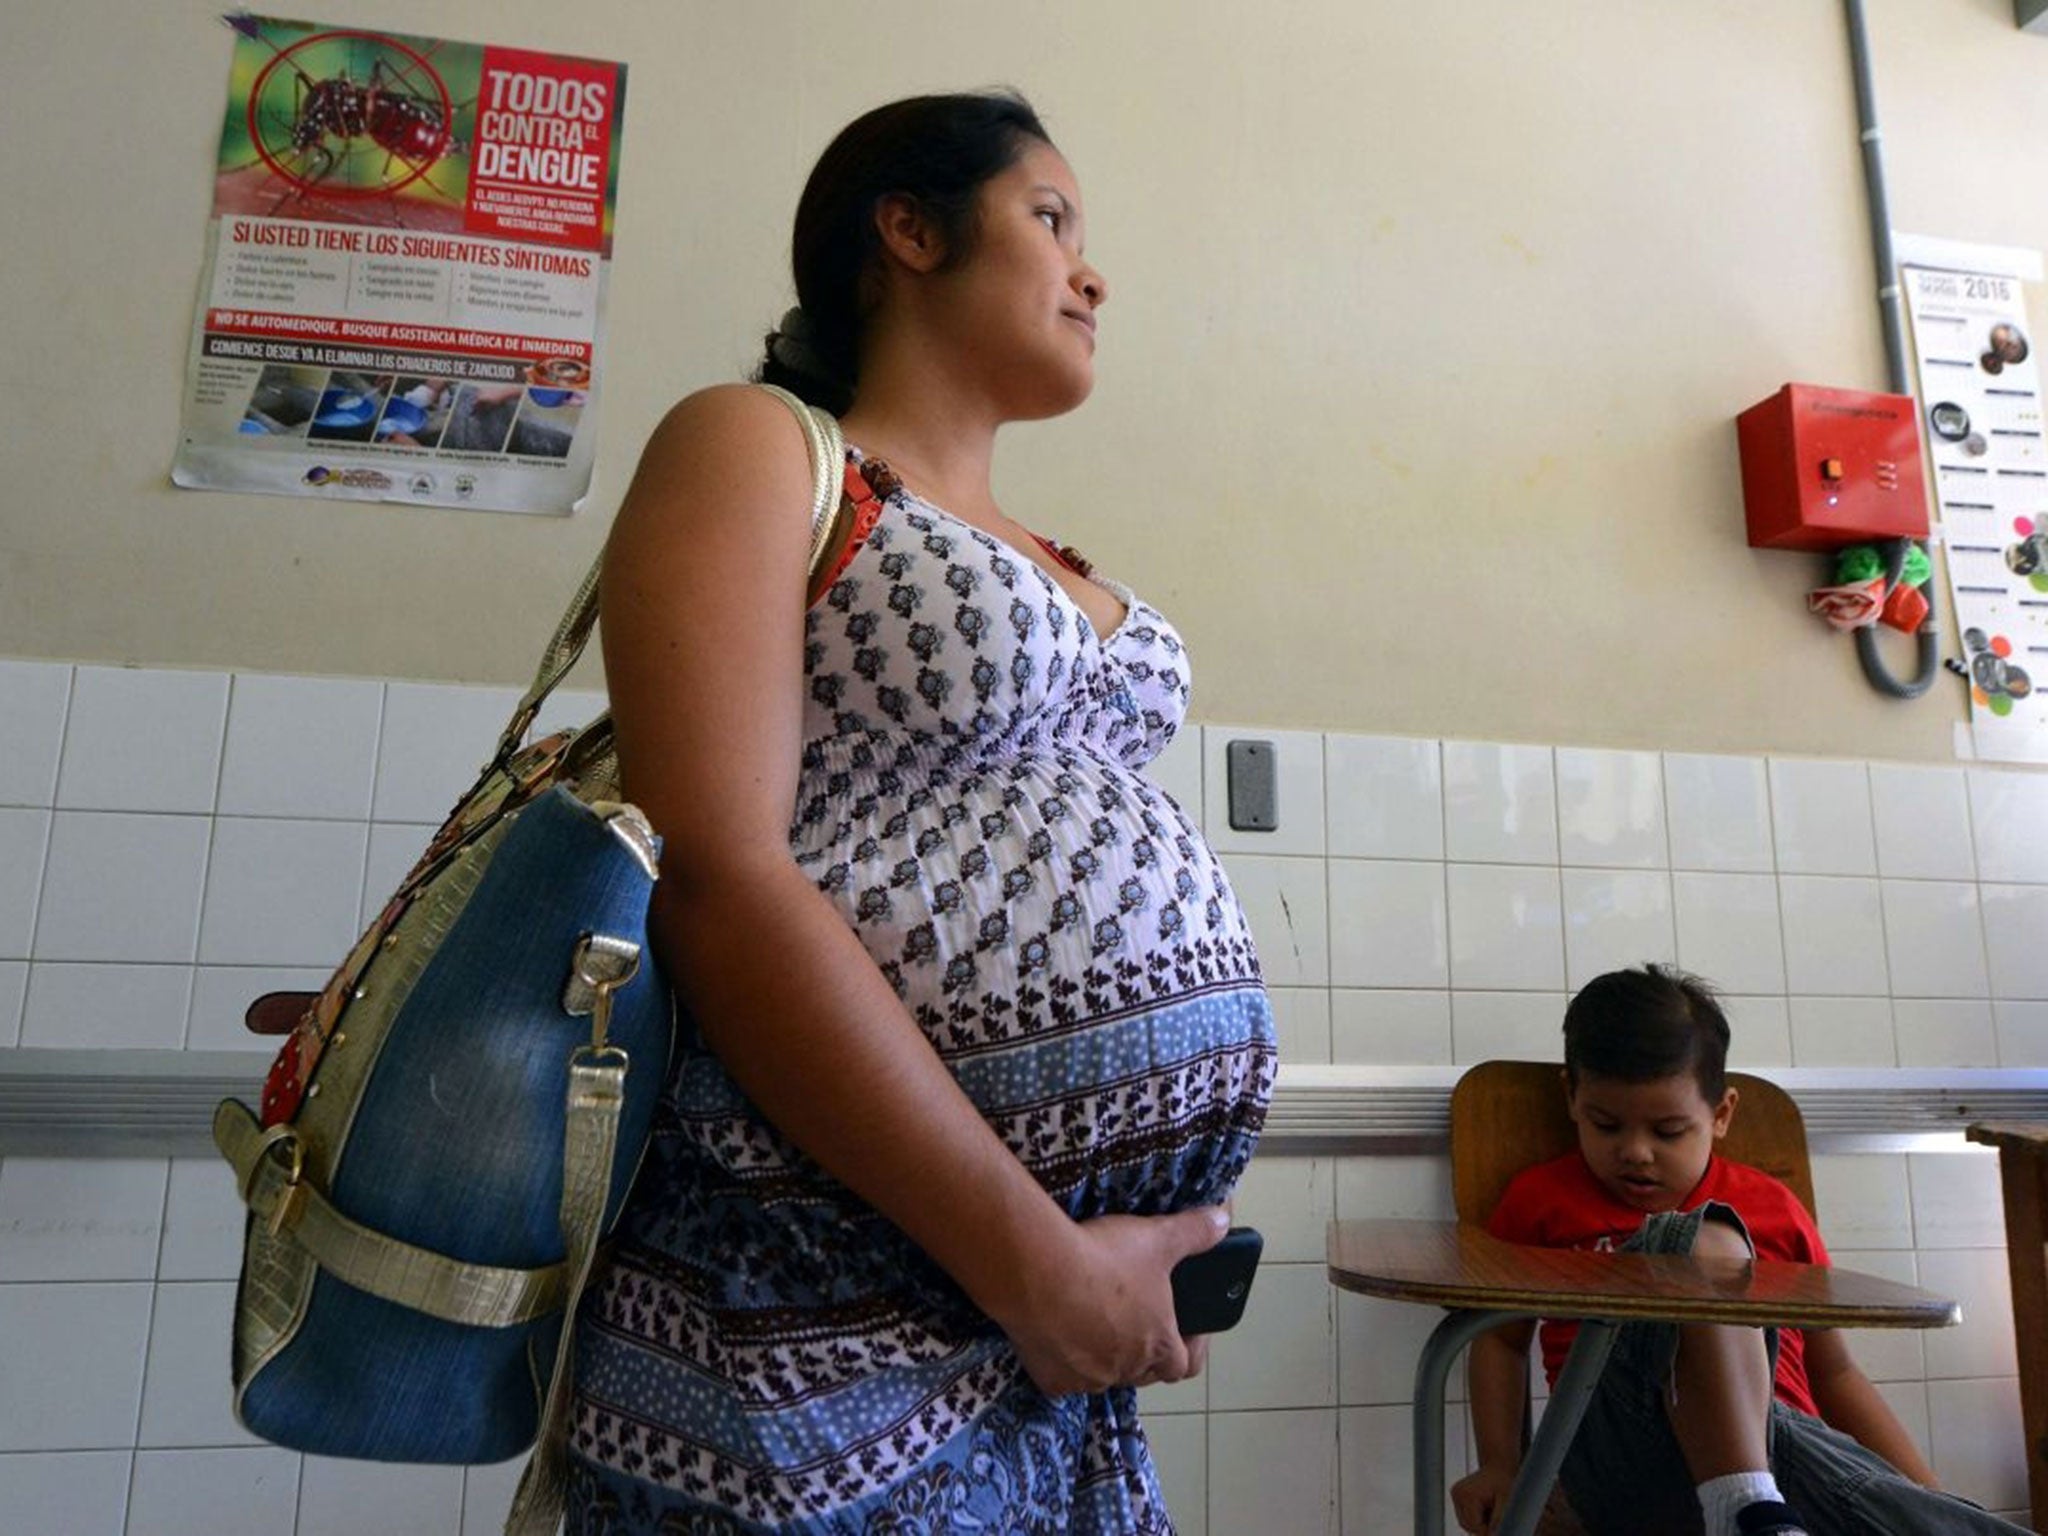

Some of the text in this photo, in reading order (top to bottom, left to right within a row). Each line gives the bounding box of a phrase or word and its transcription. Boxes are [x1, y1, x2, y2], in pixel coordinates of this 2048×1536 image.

[488, 70, 607, 122] TODOS
[481, 110, 600, 150] CONTRA EL
[477, 142, 600, 189] DENGUE
[233, 222, 592, 278] SI USTED TIENE LOS SIGUIENTES SÍNTOMAS
[1964, 277, 2010, 301] 2016
[215, 312, 585, 357] NO SE AUTOMEDIQUE, BUSQUE ASISTENCIA MÉDICA DE INMEDIATO
[210, 339, 516, 379] COMIENCE DESDE YA A ELIMINAR LOS CRIADEROS DE ZANCUDO
